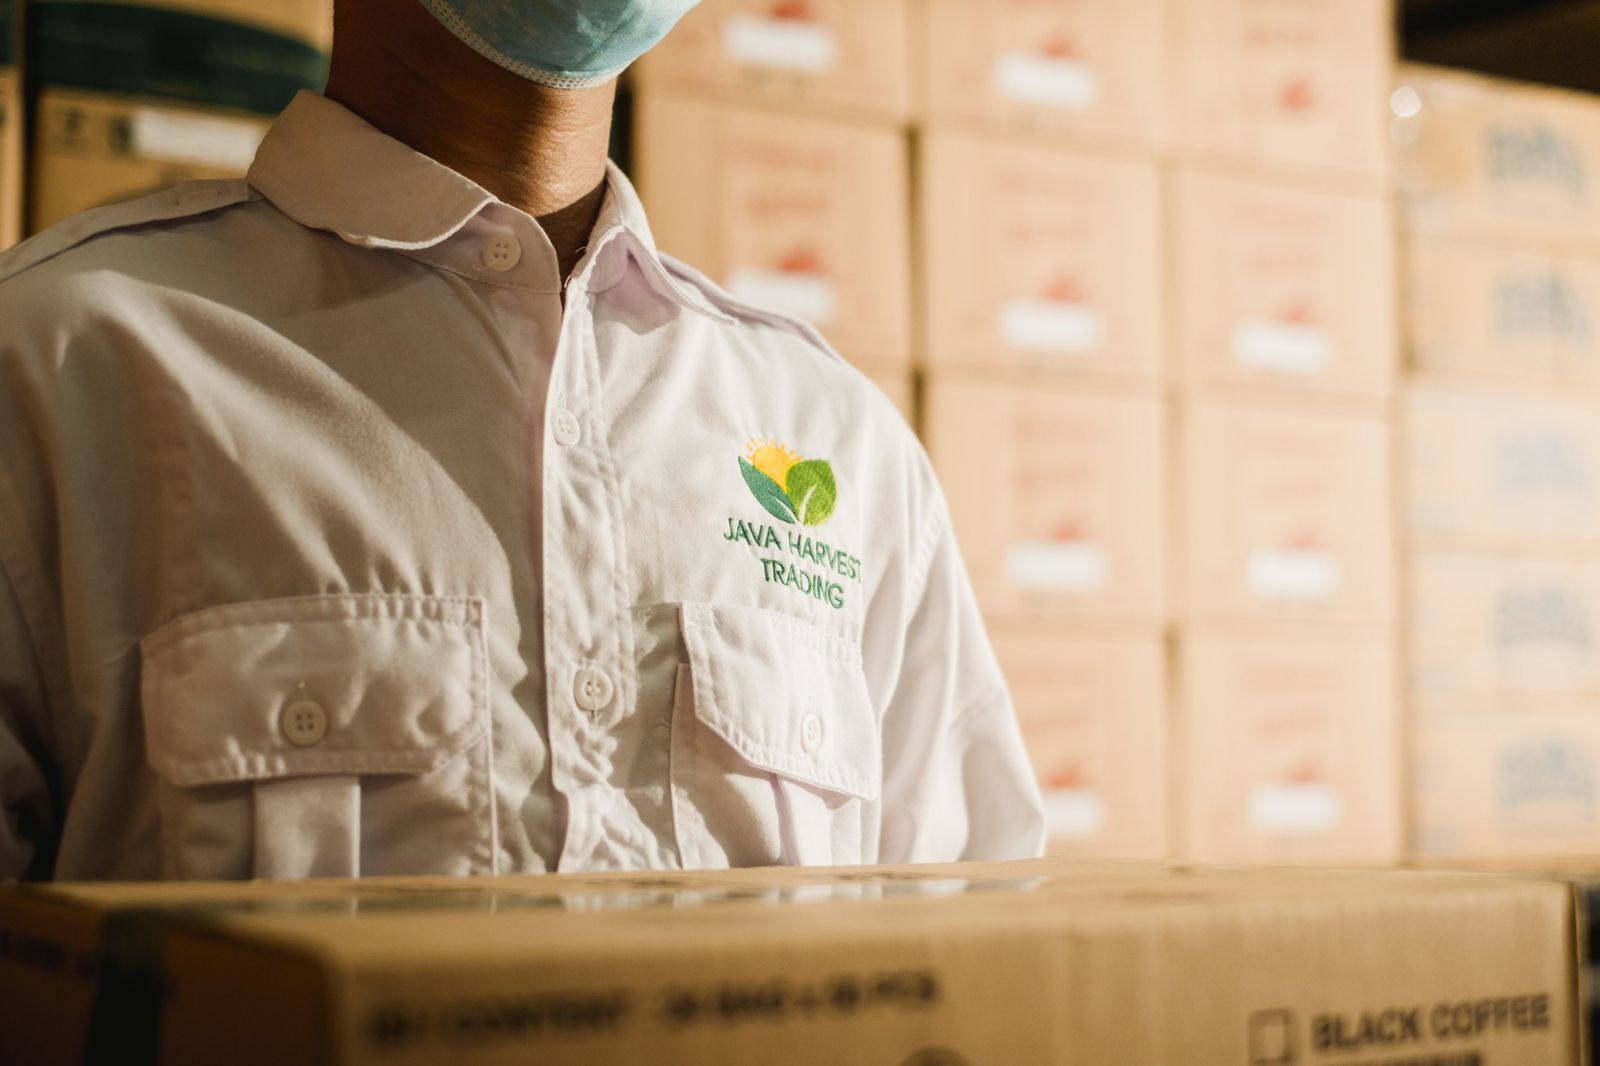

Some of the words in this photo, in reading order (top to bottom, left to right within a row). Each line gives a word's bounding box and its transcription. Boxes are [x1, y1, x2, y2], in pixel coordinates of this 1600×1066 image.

[723, 517, 782, 550] JAVA
[788, 530, 861, 582] HARVEST
[760, 557, 844, 609] TRADING
[1312, 1006, 1420, 1051] BLACK
[1430, 993, 1550, 1038] COFFEE
